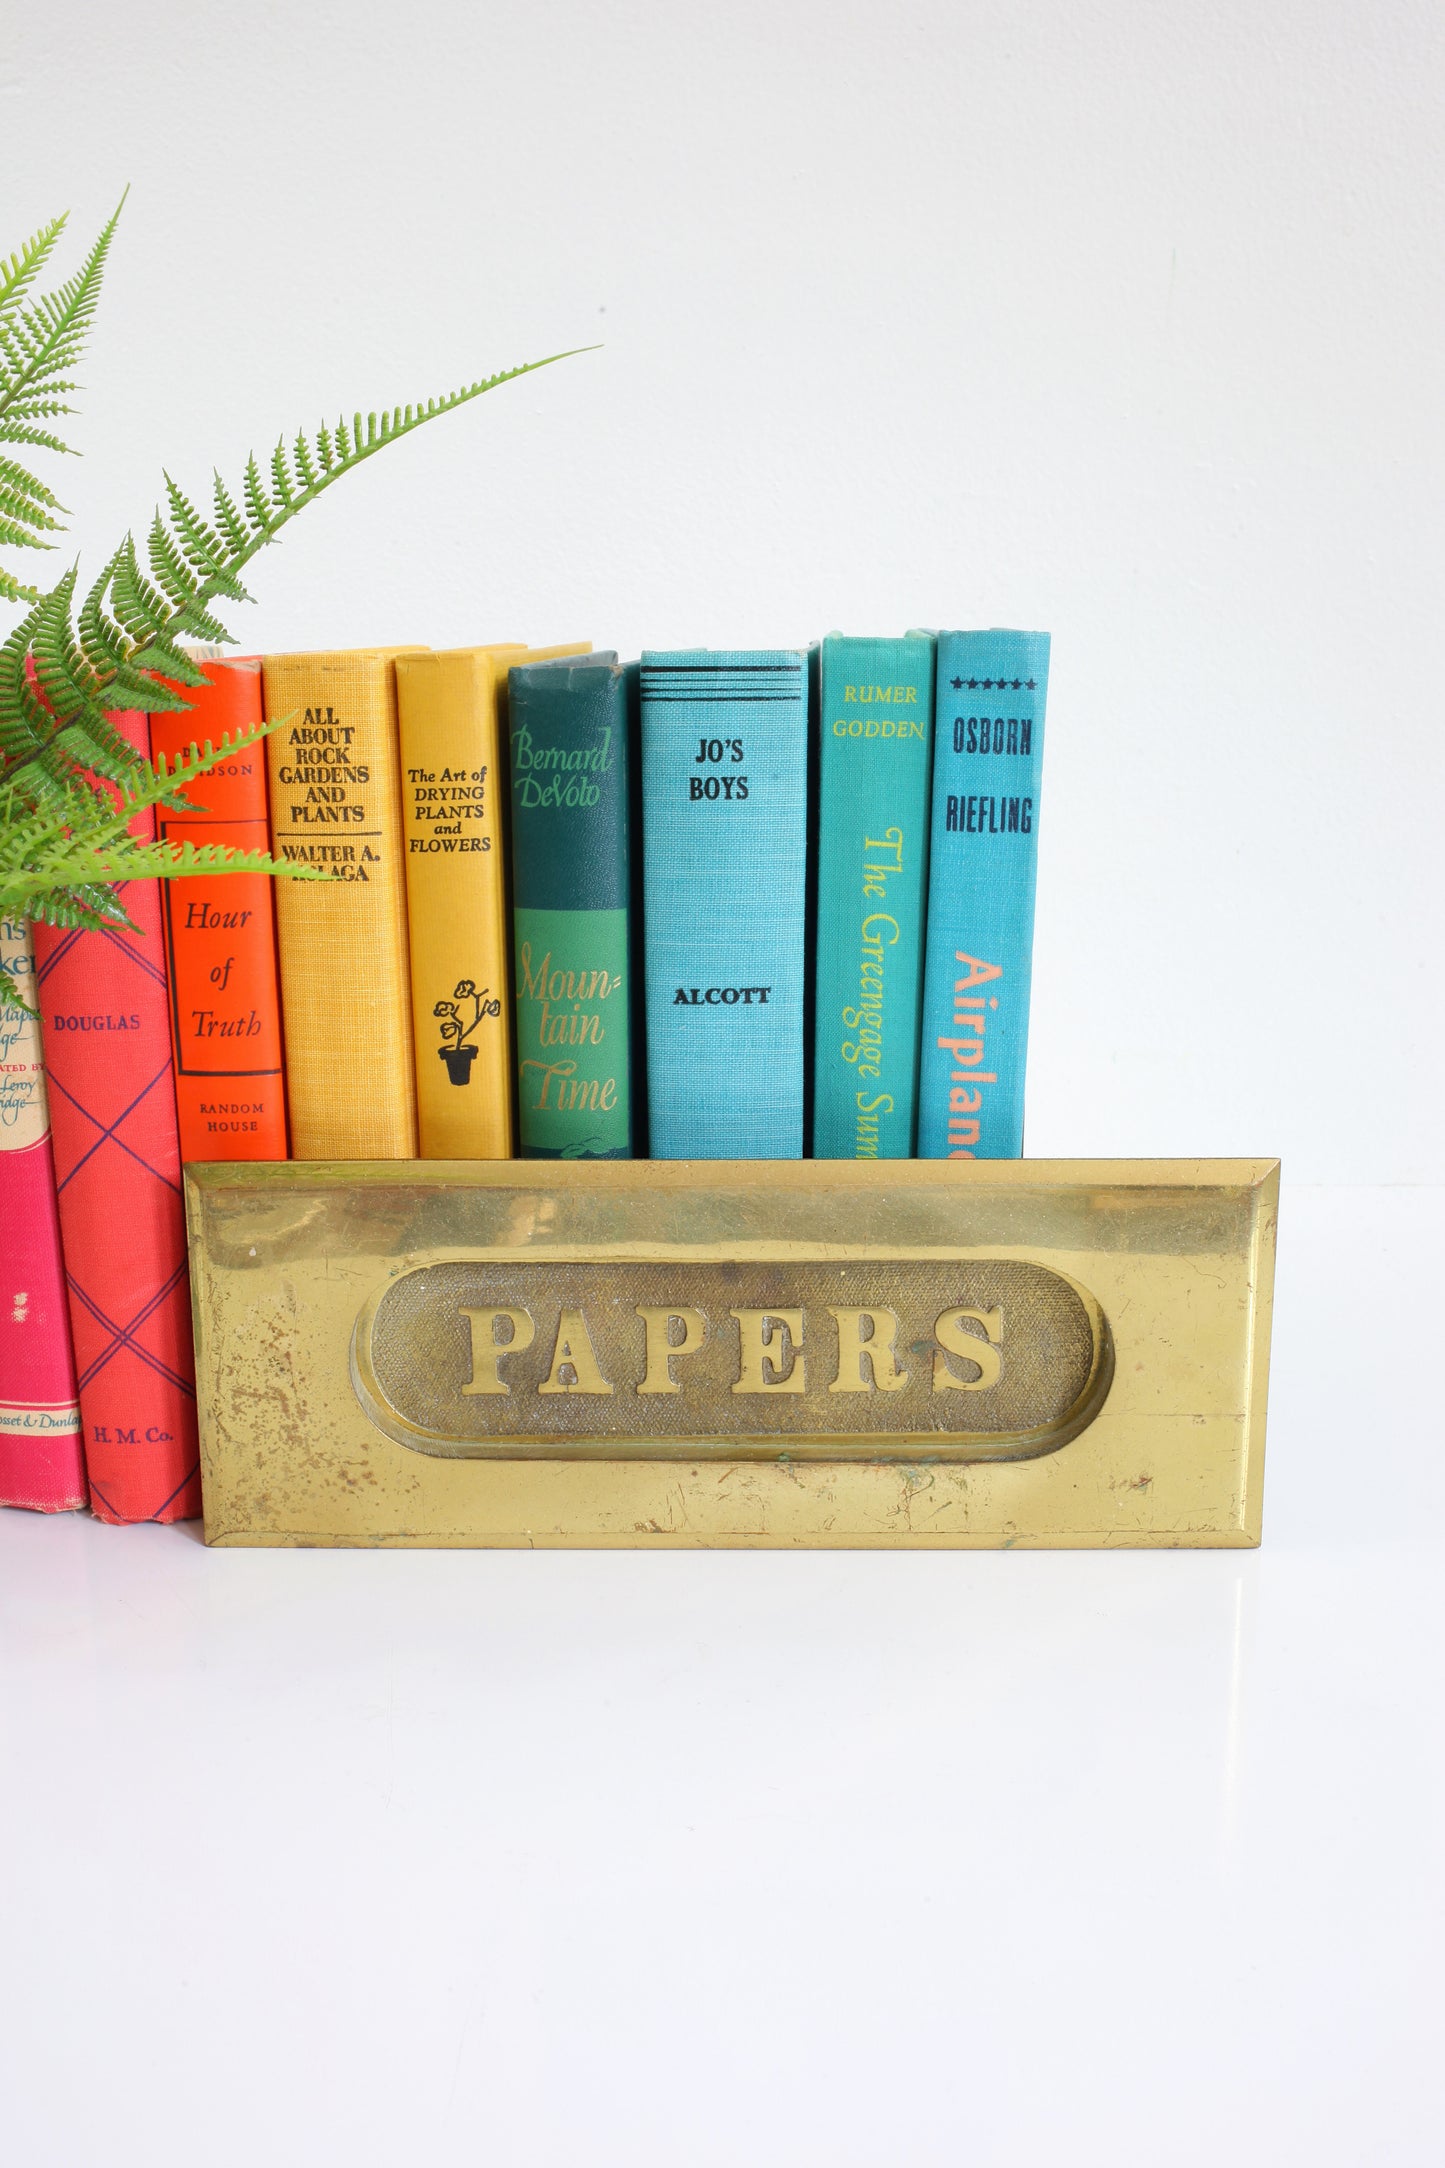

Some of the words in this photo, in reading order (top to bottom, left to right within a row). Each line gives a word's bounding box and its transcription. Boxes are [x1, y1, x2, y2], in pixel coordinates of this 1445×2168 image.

[844, 685, 917, 704] RUMER
[302, 708, 340, 725] ALL
[289, 727, 355, 745] ABOUT
[833, 719, 926, 740] GODDEN
[953, 717, 1033, 756] OSBORN
[296, 747, 351, 765] ROCK
[510, 723, 612, 772] Bernard
[695, 738, 745, 763] JO'S
[279, 766, 370, 784] GARDENS
[408, 769, 435, 783] The
[440, 768, 467, 782] Art
[471, 766, 488, 784] of
[306, 787, 346, 803] AND
[415, 787, 485, 801] DRYING
[689, 776, 749, 801] BOYS
[291, 805, 365, 823] PLANTS
[415, 805, 484, 820] PLANTS
[946, 795, 1033, 834] RIEFLING
[434, 821, 462, 835] and
[281, 845, 356, 862] WALTER
[361, 845, 381, 862] A.
[409, 837, 491, 853] FLOWERS
[863, 827, 903, 898] The
[185, 903, 252, 929] Hour
[210, 957, 235, 991] of
[673, 987, 771, 1006] ALCOTT
[841, 913, 900, 1078] Greengage
[54, 1015, 140, 1031] DOUGLAS
[191, 1010, 261, 1037] Truth
[539, 1001, 605, 1048] tain
[520, 1059, 618, 1111] Time
[200, 1103, 265, 1114] RANDOM
[207, 1121, 258, 1132] HOUSE
[458, 1305, 1002, 1396] PAPERS
[23, 1414, 37, 1427] &
[94, 1427, 111, 1443] H.
[117, 1429, 141, 1444] M.
[145, 1427, 173, 1443] Co.
